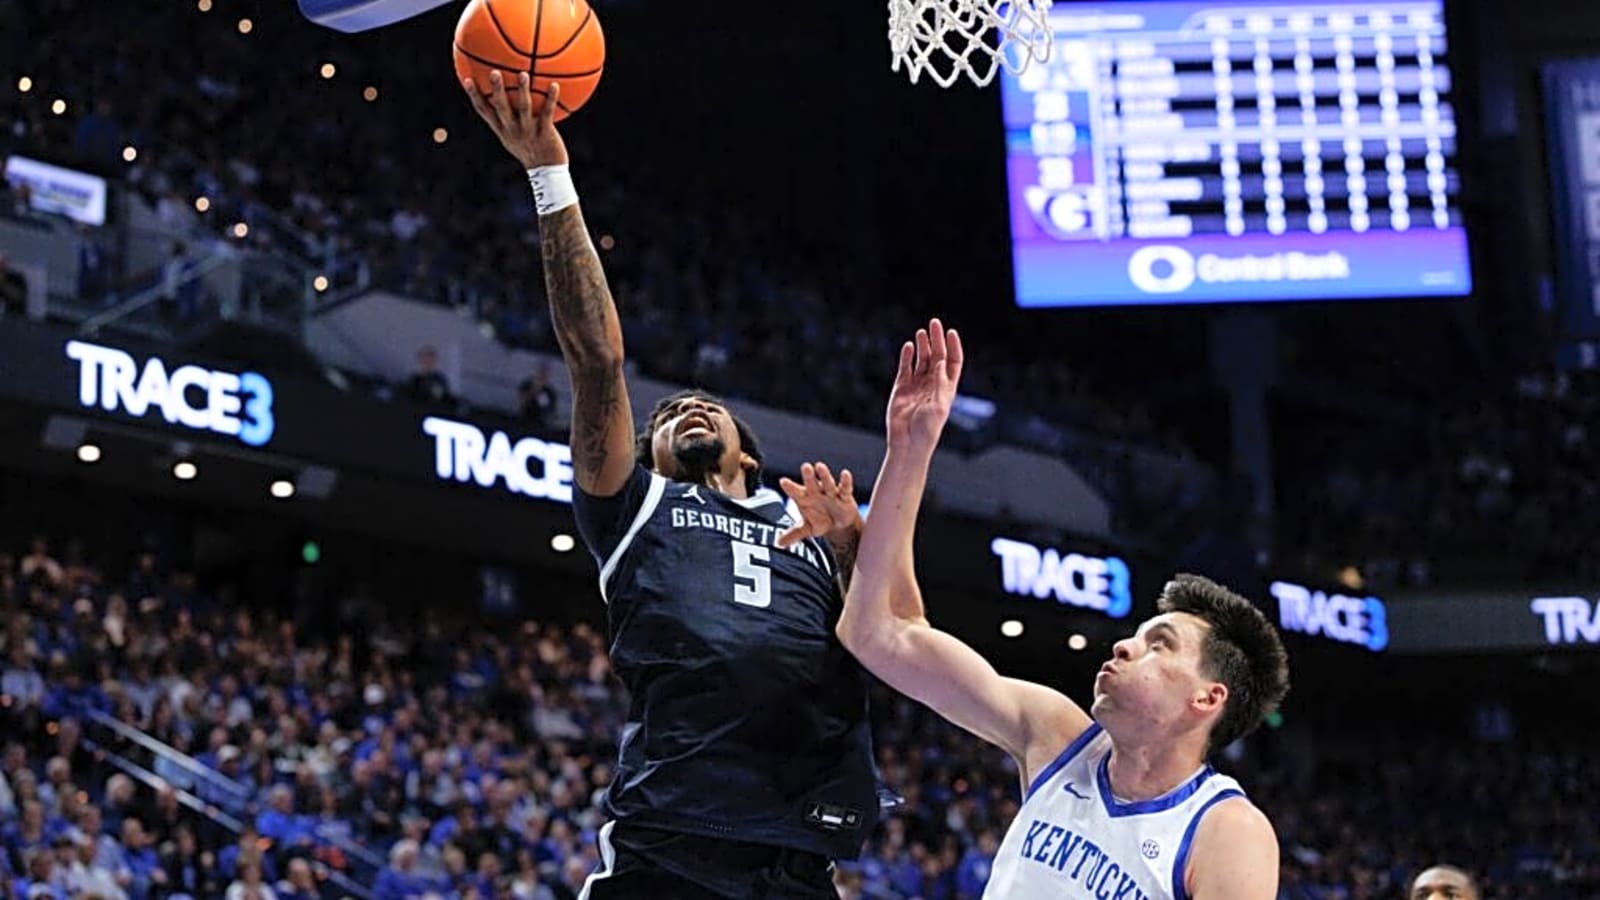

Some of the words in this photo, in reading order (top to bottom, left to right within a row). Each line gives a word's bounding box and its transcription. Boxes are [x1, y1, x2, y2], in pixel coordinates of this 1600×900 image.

[66, 340, 275, 446] TRACE3
[731, 539, 772, 608] 5
[991, 537, 1132, 619] TRACE3
[1269, 580, 1389, 653] TRACE3
